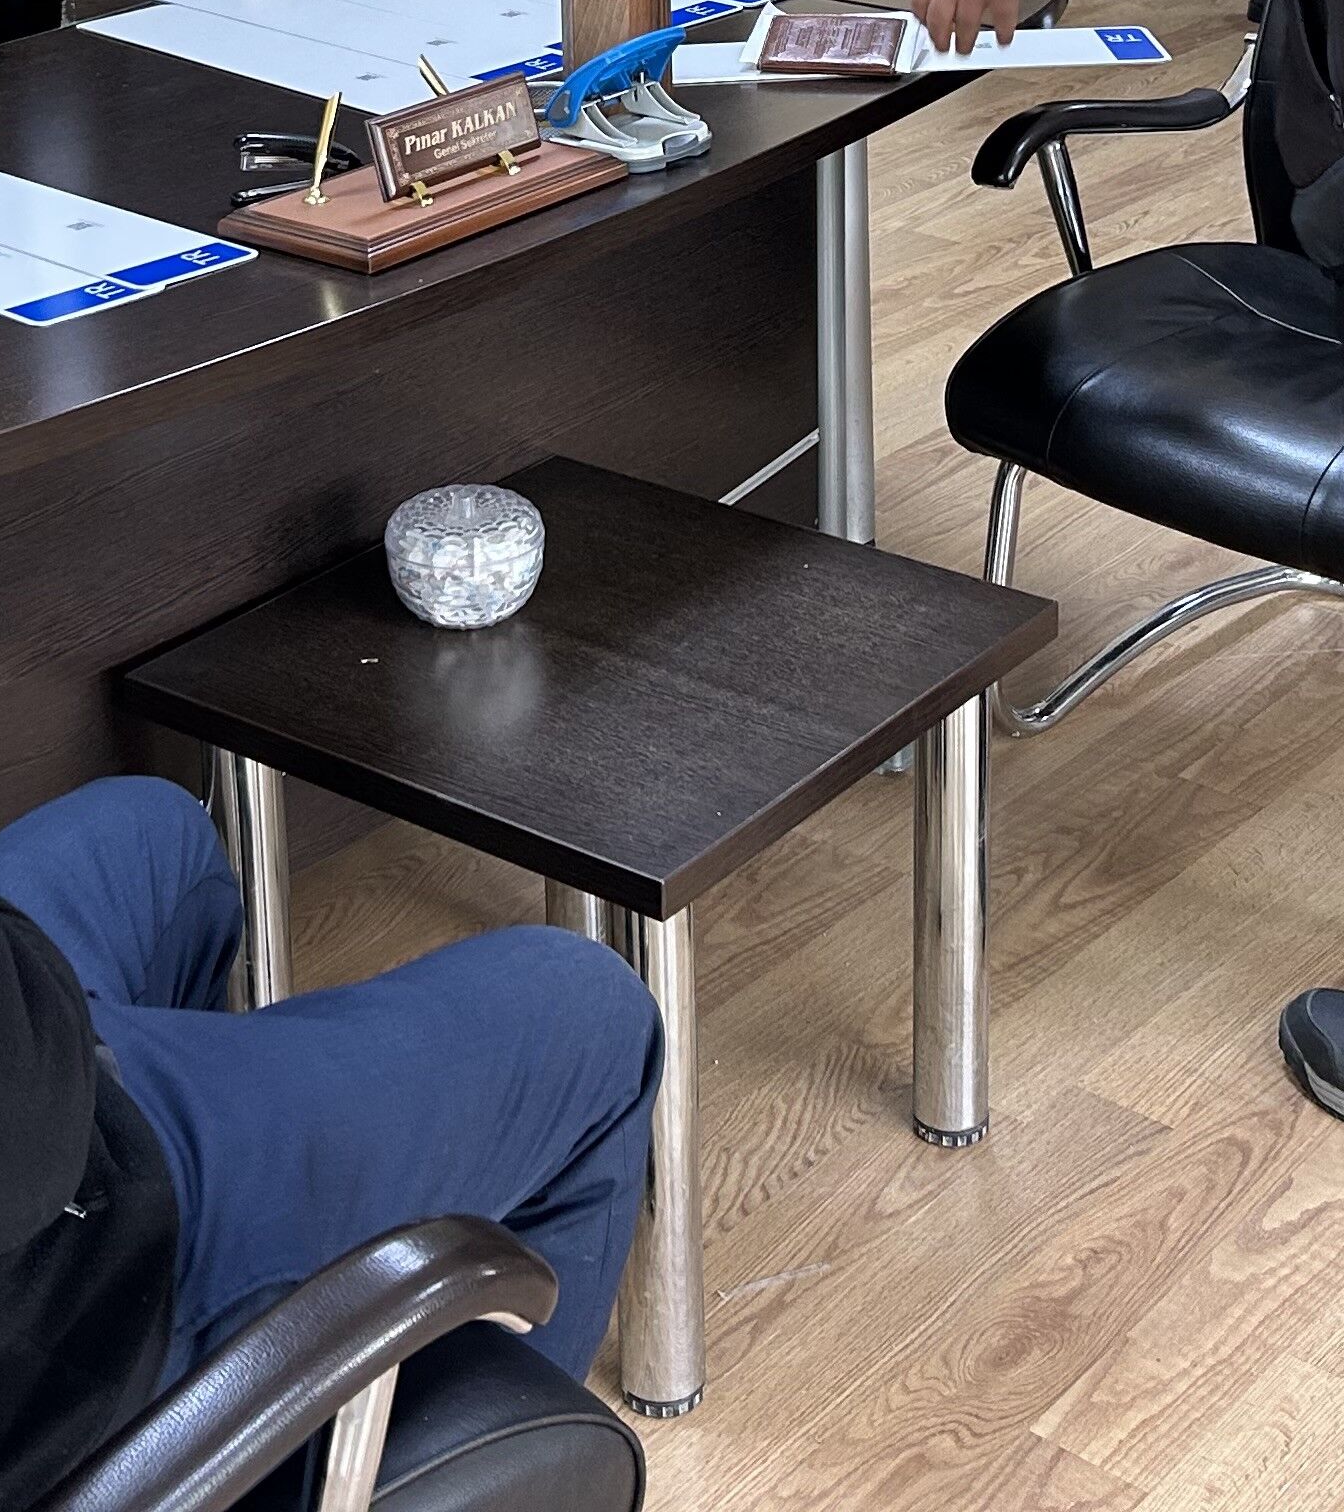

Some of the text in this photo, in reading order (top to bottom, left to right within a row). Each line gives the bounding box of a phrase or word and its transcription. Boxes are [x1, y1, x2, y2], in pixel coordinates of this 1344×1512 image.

[684, 4, 716, 16] TR
[1103, 33, 1143, 43] TR
[524, 58, 558, 70] TR
[451, 101, 517, 139] KALKAN
[433, 142, 461, 159] Genel
[180, 249, 221, 266] TR
[83, 281, 126, 300] TR
